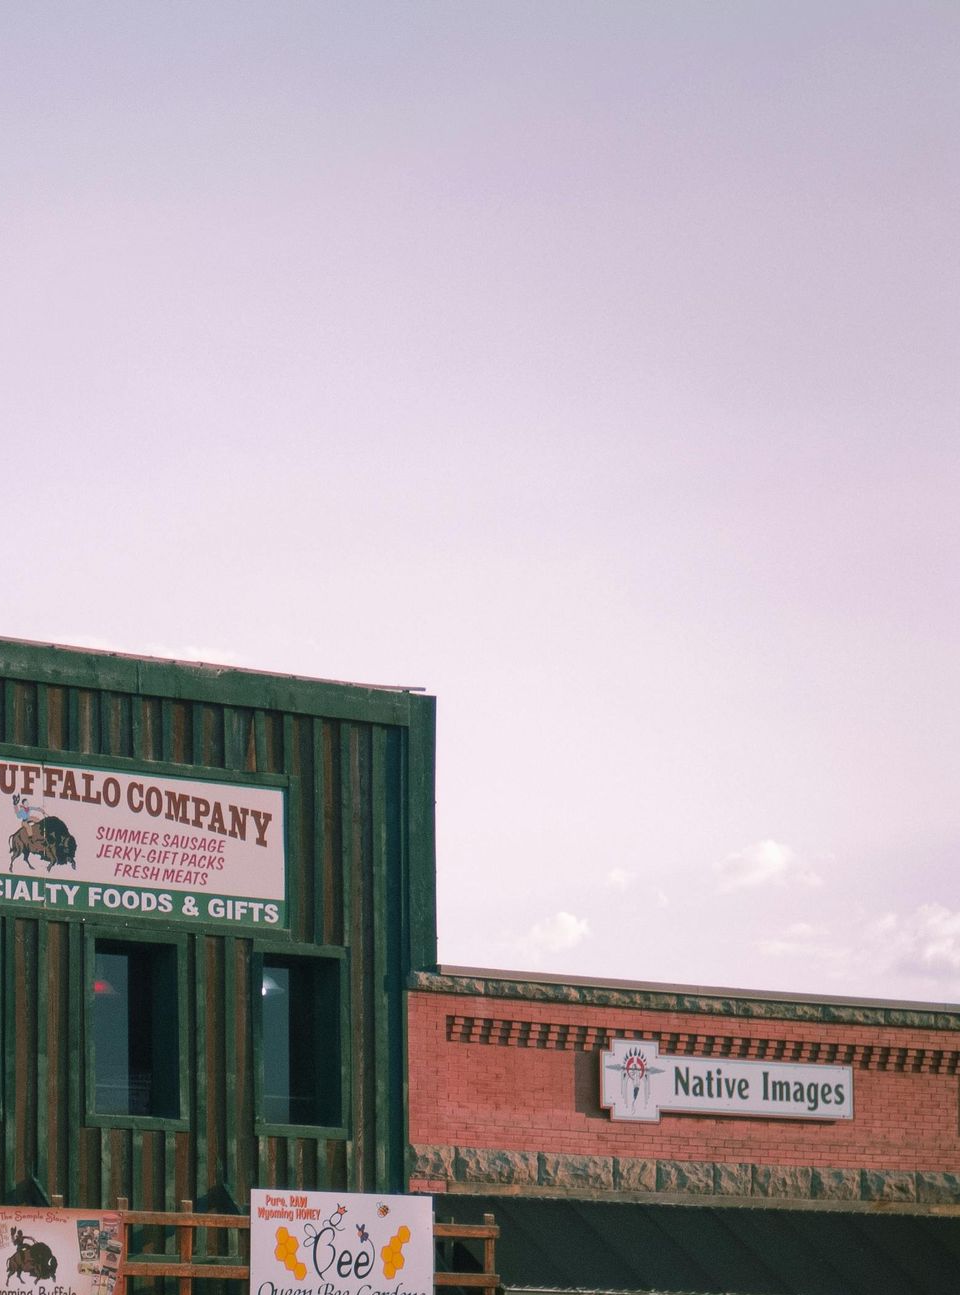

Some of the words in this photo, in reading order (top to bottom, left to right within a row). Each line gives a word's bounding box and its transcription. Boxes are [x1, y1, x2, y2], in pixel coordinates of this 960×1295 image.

[127, 782, 273, 848] COMPANY
[96, 826, 162, 848] SUMMER
[163, 832, 227, 855] SAUSAGE
[96, 844, 175, 866] JERKY-GIFT
[176, 851, 226, 871] PACKS
[114, 861, 159, 882] FRESH
[159, 866, 208, 886] MEATS
[88, 886, 172, 912] FOODS
[181, 895, 200, 917] &
[207, 897, 280, 924] GIFTS
[674, 1066, 750, 1100] Native
[762, 1071, 845, 1111] Images
[257, 1207, 294, 1222] Wyoming
[296, 1209, 320, 1220] HONEY
[290, 1196, 307, 1207] RAW
[15, 1210, 43, 1223] Sample
[313, 1227, 375, 1280] Bee
